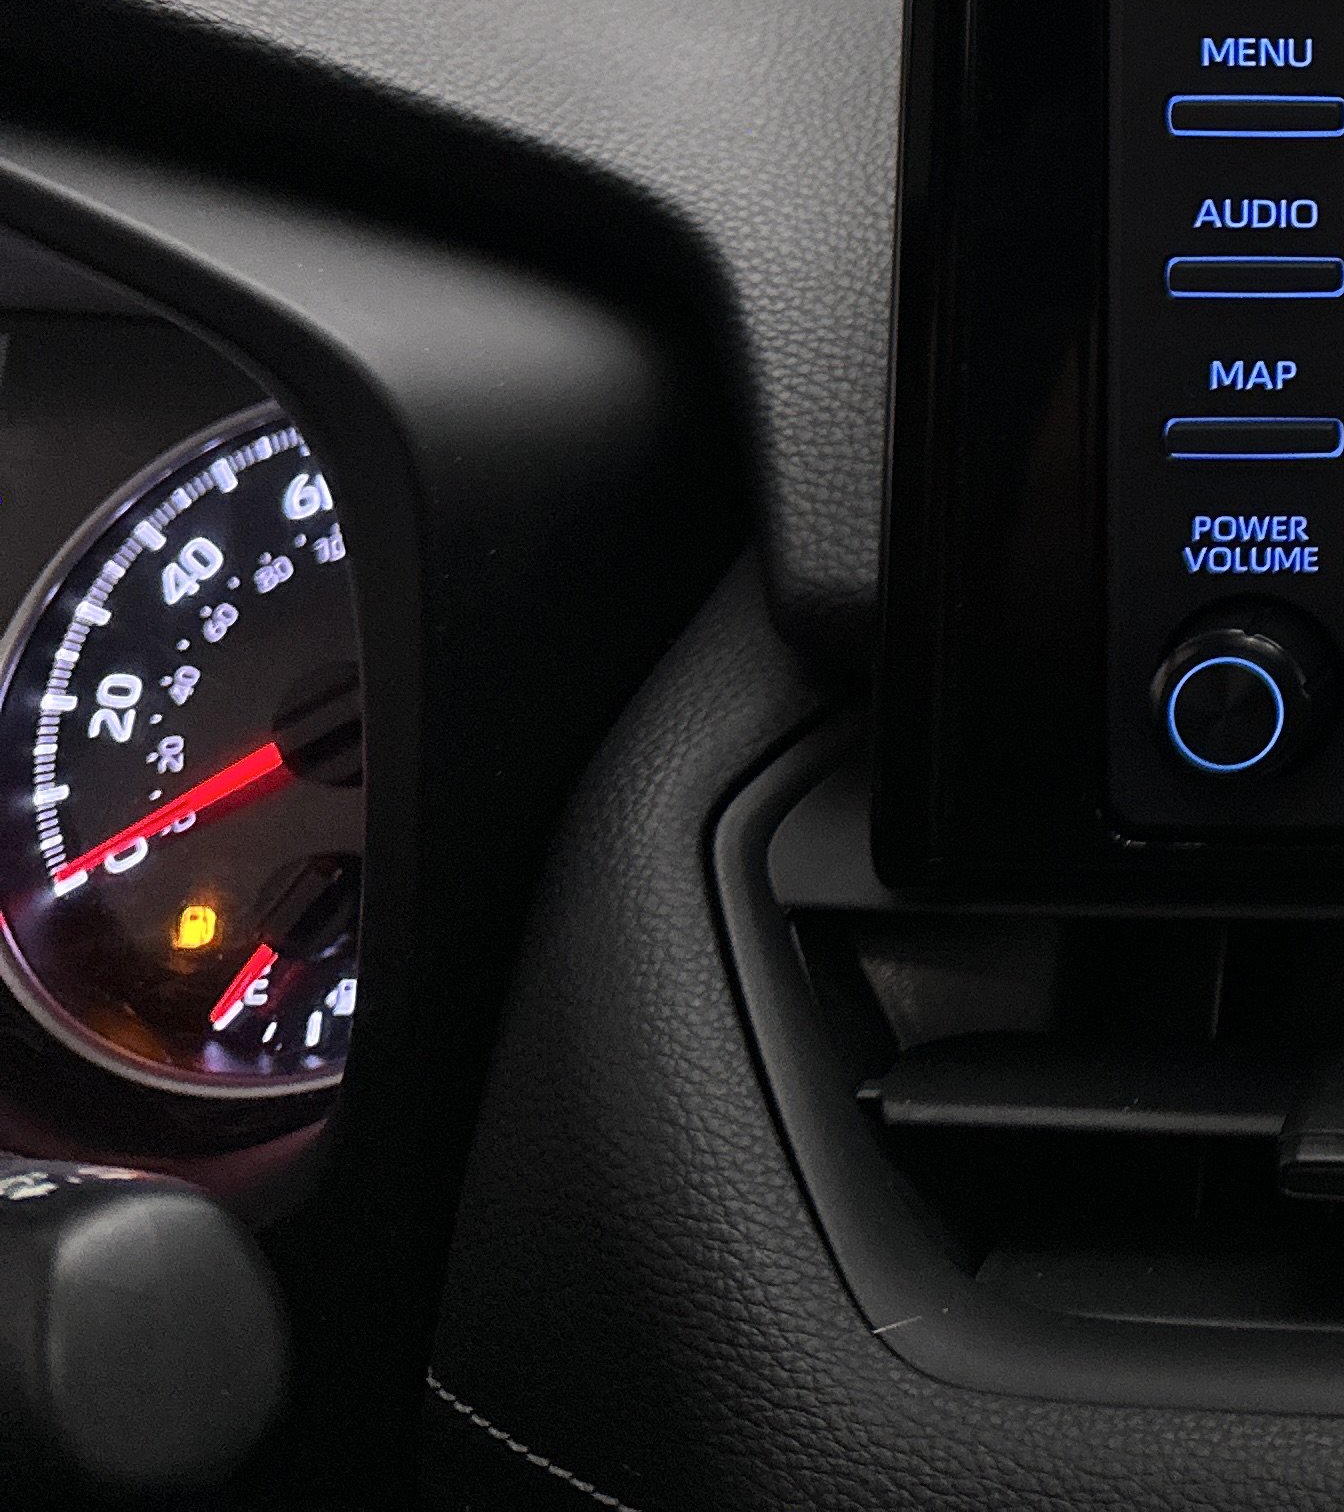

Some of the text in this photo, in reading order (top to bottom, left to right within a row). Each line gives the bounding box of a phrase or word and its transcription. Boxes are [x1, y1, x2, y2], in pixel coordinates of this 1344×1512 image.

[1201, 37, 1314, 68] MENU
[1193, 199, 1320, 229] AUDIO
[1208, 360, 1299, 390] MAP
[1191, 515, 1309, 543] POWER
[162, 536, 224, 605] 40
[1184, 546, 1320, 574] VOLUME
[202, 602, 239, 643] 60
[168, 665, 201, 706] 40
[87, 673, 143, 743] 20
[156, 735, 185, 775] 20
